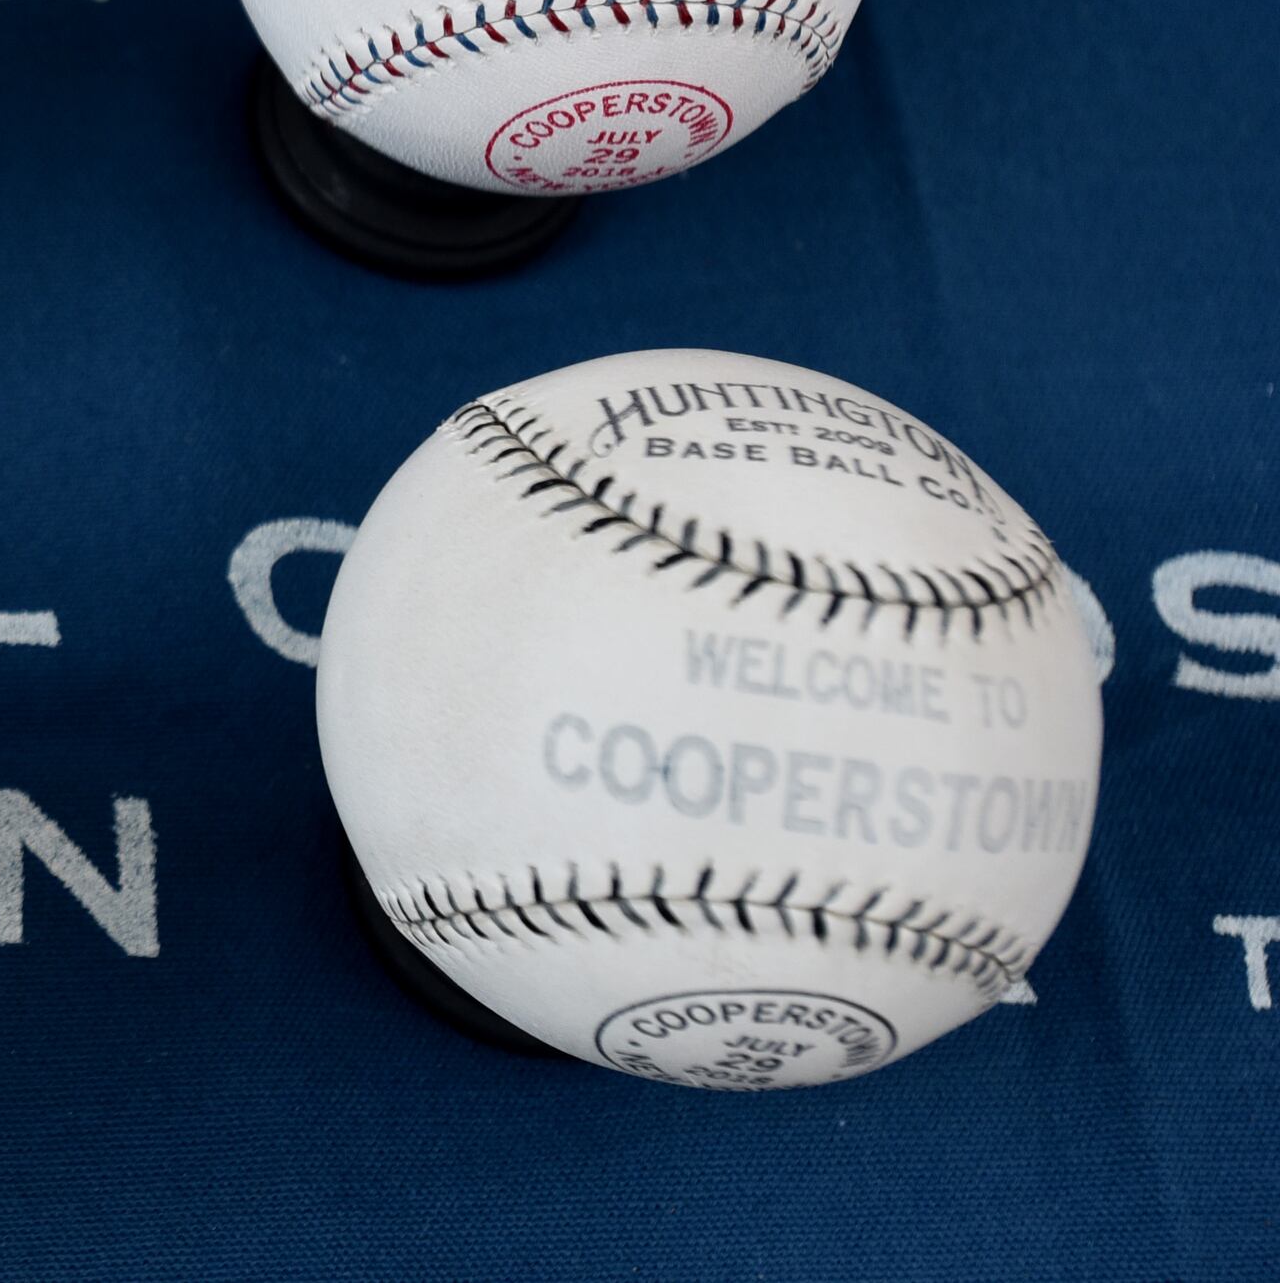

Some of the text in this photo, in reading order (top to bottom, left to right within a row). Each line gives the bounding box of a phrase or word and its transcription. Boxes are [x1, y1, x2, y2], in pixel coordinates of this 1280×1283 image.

[509, 92, 719, 148] COOPERSTOWN
[587, 130, 663, 145] JULY
[584, 148, 640, 165] 29
[588, 382, 1005, 526] HUNTINGTON
[645, 437, 985, 515] BASE BALL CO.
[684, 628, 1029, 732] WELCOME TO
[541, 714, 1089, 855] COOPERSTOWN
[723, 1035, 815, 1057] JULY
